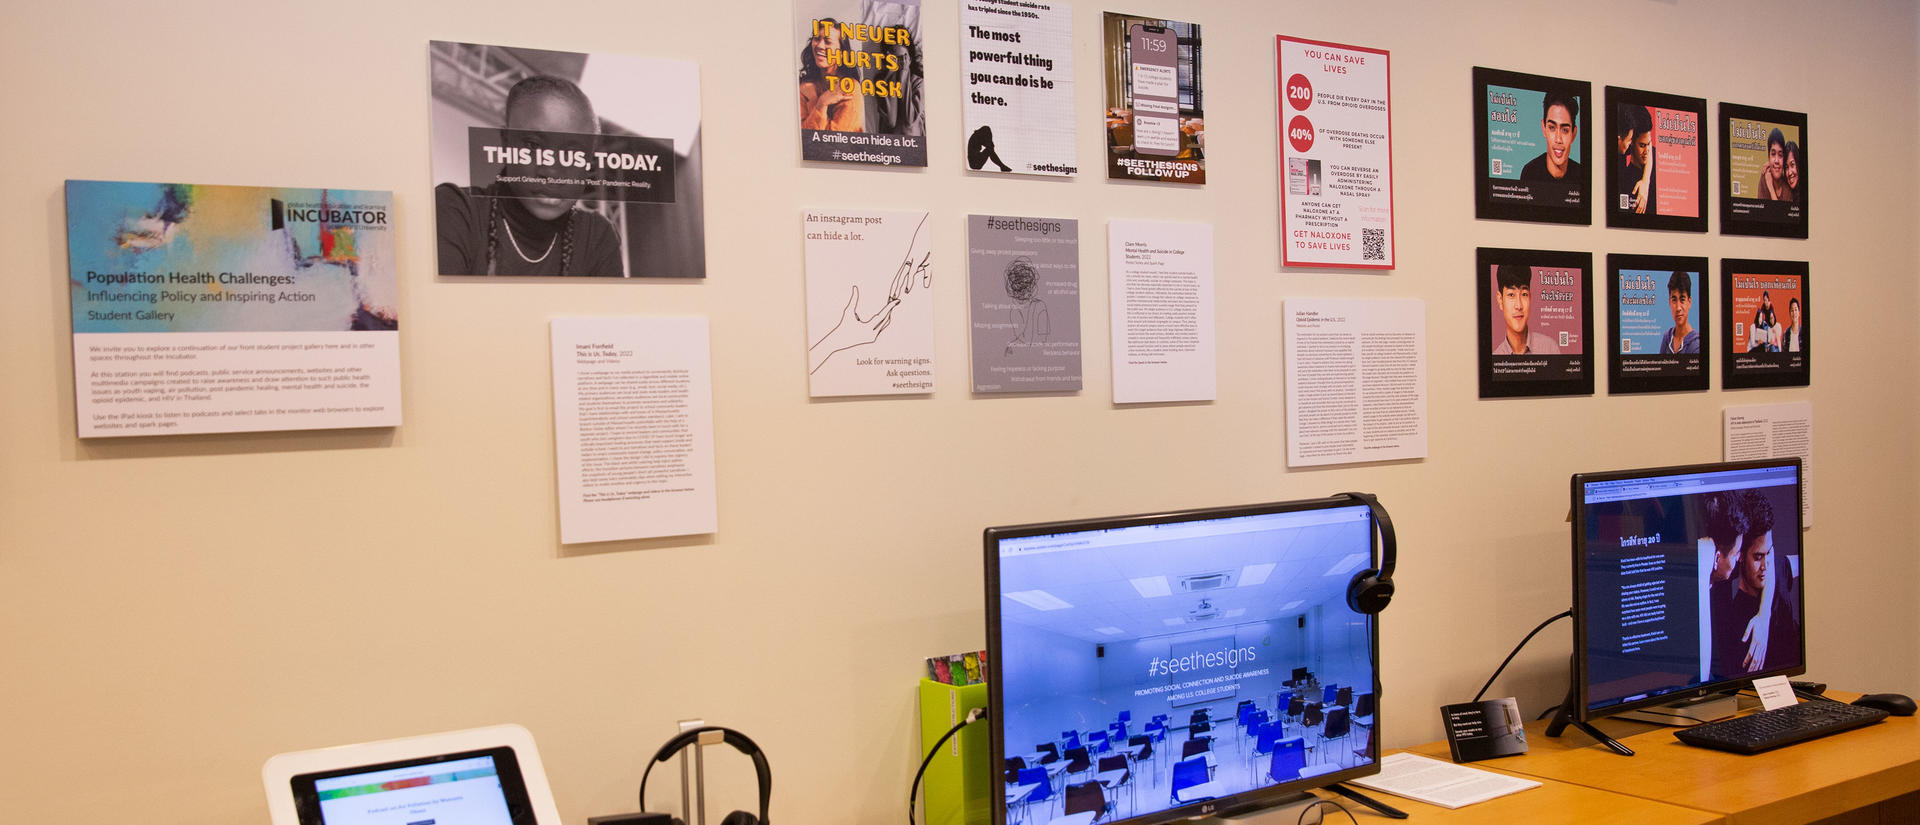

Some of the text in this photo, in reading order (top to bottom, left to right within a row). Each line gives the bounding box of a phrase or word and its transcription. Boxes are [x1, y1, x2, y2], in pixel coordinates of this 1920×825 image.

[812, 19, 833, 37] IT
[969, 26, 1020, 43] The most
[1141, 38, 1166, 52] 11:59
[827, 48, 899, 71] HURTS
[970, 49, 1052, 71] powerful thing
[1305, 50, 1365, 65] YOU CAN SAVE
[1324, 64, 1346, 74] LIVES
[825, 76, 902, 99] TO ASK
[971, 72, 1053, 89] you can do is be
[971, 92, 1007, 106] there.
[1290, 86, 1310, 100] 200
[812, 132, 820, 142] A
[823, 132, 848, 144] smile
[850, 136, 869, 145] can
[871, 136, 891, 146] hide
[903, 137, 918, 147] lot.
[1291, 128, 1312, 140] 40%
[483, 146, 662, 171] THIS IS US, TODAY.
[832, 150, 901, 165] #seethesigns
[1117, 158, 1198, 171] #SEETHESIGNS
[1026, 163, 1077, 175] #seethesigns
[1128, 166, 1189, 178] FOLLOW UP
[288, 210, 386, 224] INCUBATOR
[821, 214, 863, 225] instagram
[865, 217, 882, 226] post
[987, 216, 1061, 235] #seethesigns
[824, 231, 842, 240] hide
[850, 232, 864, 241] lot.
[1311, 232, 1351, 240] NALOXONE
[87, 271, 295, 286] Population Health Challenges:
[88, 291, 315, 303] Influencing Policy and Inspiring Action
[89, 310, 174, 322] Student Gallery
[913, 358, 932, 366] signs.
[1149, 646, 1256, 676] #seethesigns
[1135, 687, 1163, 696] PROMOTING
[1183, 678, 1214, 688] CONNECTION
[1242, 669, 1269, 678] AWARENESS
[1195, 688, 1216, 697] COLLEGE
[1217, 684, 1240, 693] STUDENTS
